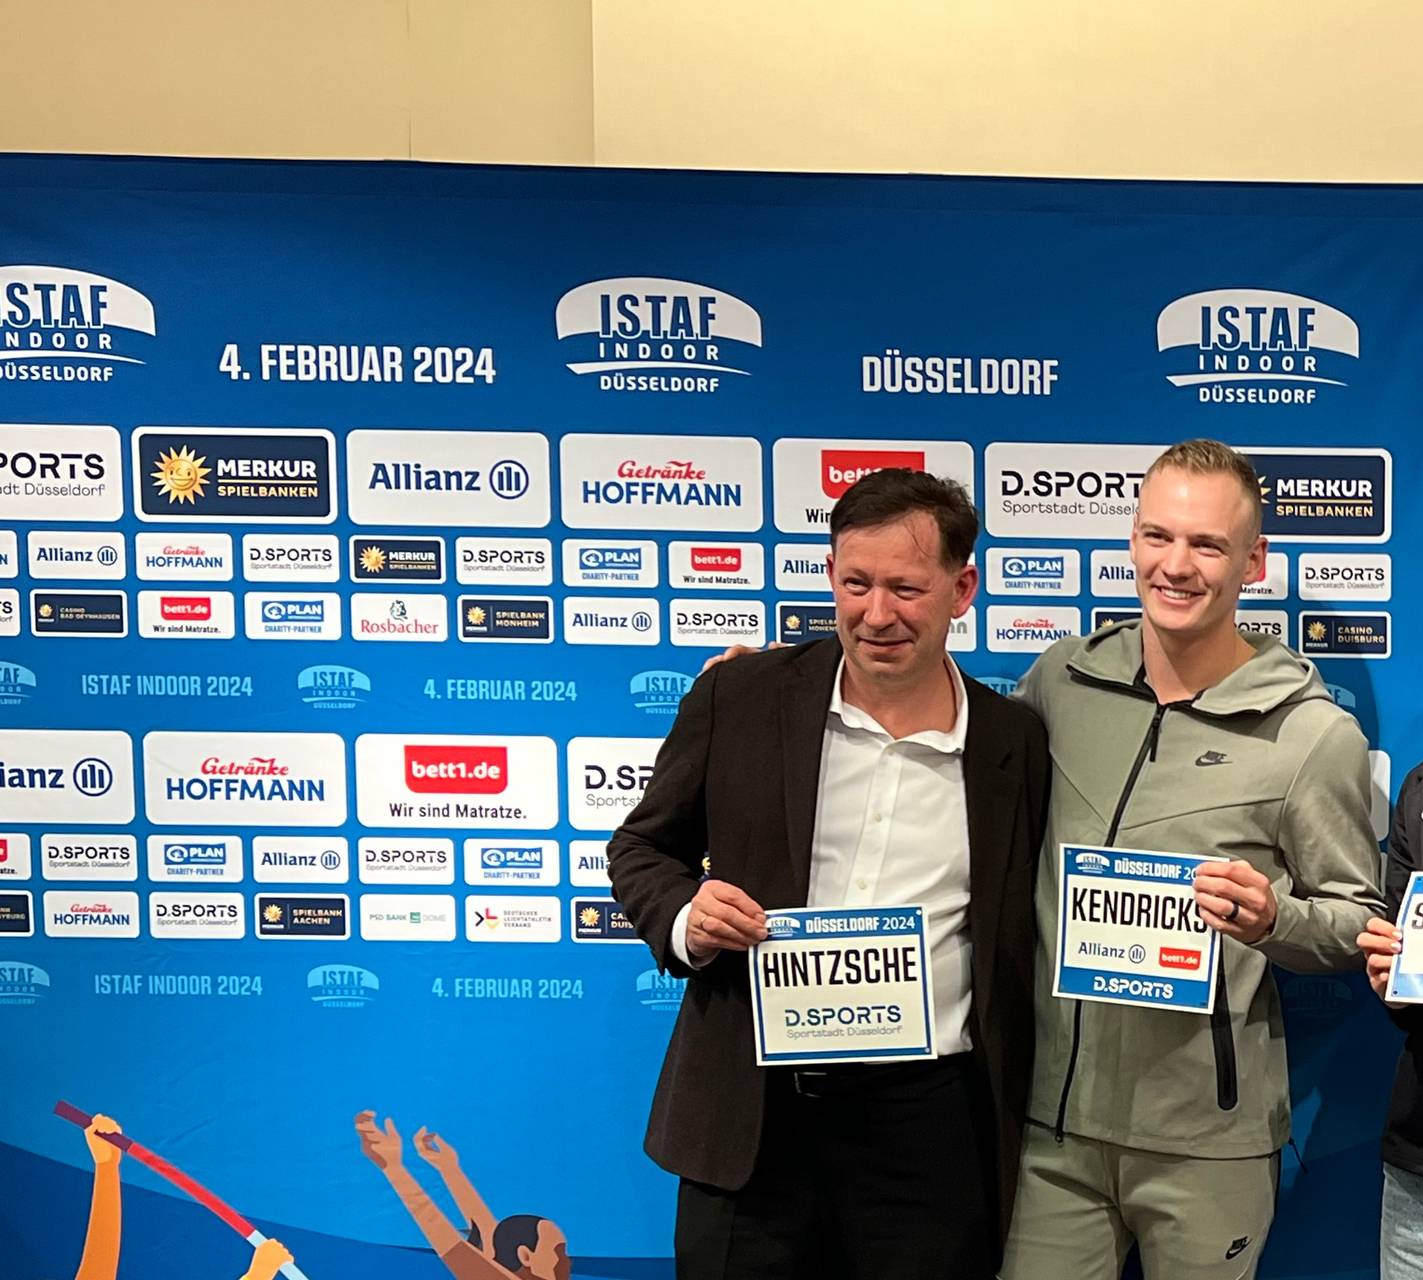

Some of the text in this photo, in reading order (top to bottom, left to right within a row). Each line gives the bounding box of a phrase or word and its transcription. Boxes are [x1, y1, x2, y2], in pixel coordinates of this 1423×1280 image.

[599, 294, 717, 339] ISTAF
[1199, 306, 1316, 352] ISTAF
[600, 343, 718, 360] INDOOR
[220, 344, 496, 383] 4. FEBRUAR 2024
[1200, 355, 1315, 371] INDOOR
[863, 349, 1058, 395] DÜSSELDORF
[601, 373, 718, 392] DÜSSELDORF
[1200, 385, 1315, 403] DÜSSELDORF
[218, 460, 316, 477] MERKUR
[617, 460, 706, 481] Getränke
[369, 463, 480, 491] Allianz
[218, 484, 318, 497] SPIELBANKEN
[583, 481, 741, 506] HOFFMANN
[1277, 479, 1372, 497] MERKUR
[1276, 503, 1373, 517] SPIELBANKEN
[37, 548, 92, 561] Allianz
[146, 556, 223, 567] HOFFMANN
[250, 548, 332, 561] D.SPORTS
[389, 552, 436, 564] MERKUR
[463, 550, 544, 563] D.SPORTS
[605, 552, 640, 562] PLAN
[695, 554, 736, 565] bett1.de
[1028, 561, 1061, 571] PLAN
[1306, 568, 1384, 580] D.SPORTS
[287, 604, 322, 616] PLAN
[360, 619, 439, 635] Rosbacher
[573, 614, 627, 627] Allianz
[677, 613, 758, 626] D.SPORTS
[82, 675, 253, 696] ISTAF INDOOR 2024
[424, 679, 577, 701] 4. FEBRUAR 2024
[200, 755, 290, 777] Getränke
[412, 761, 500, 779] bett1.de
[167, 778, 324, 801] HOFFMANN
[390, 804, 526, 818] Wir sind Matratze.
[48, 847, 129, 859] D.SPORTS
[189, 847, 224, 857] PLAN
[262, 853, 316, 865] Allianz
[366, 850, 446, 863] D.SPORTS
[506, 851, 541, 862] PLAN
[157, 905, 237, 917] D.SPORTS
[293, 908, 342, 918] SPIELBANK
[54, 914, 129, 925] HOFFMANN
[293, 915, 331, 924] AACHEN
[806, 916, 915, 933] DÜSSELDORF 2024
[1079, 942, 1125, 958] Allianz
[763, 947, 917, 988] HINTZSCHE
[95, 975, 262, 995] ISTAF INDOOR 2024
[432, 978, 583, 998] 4. FEBRUAR 2024
[1094, 977, 1173, 998] D.SPORTS
[785, 1005, 901, 1026] D.SPORTS
[787, 1026, 902, 1040] Sportstadt Düsseldorf
